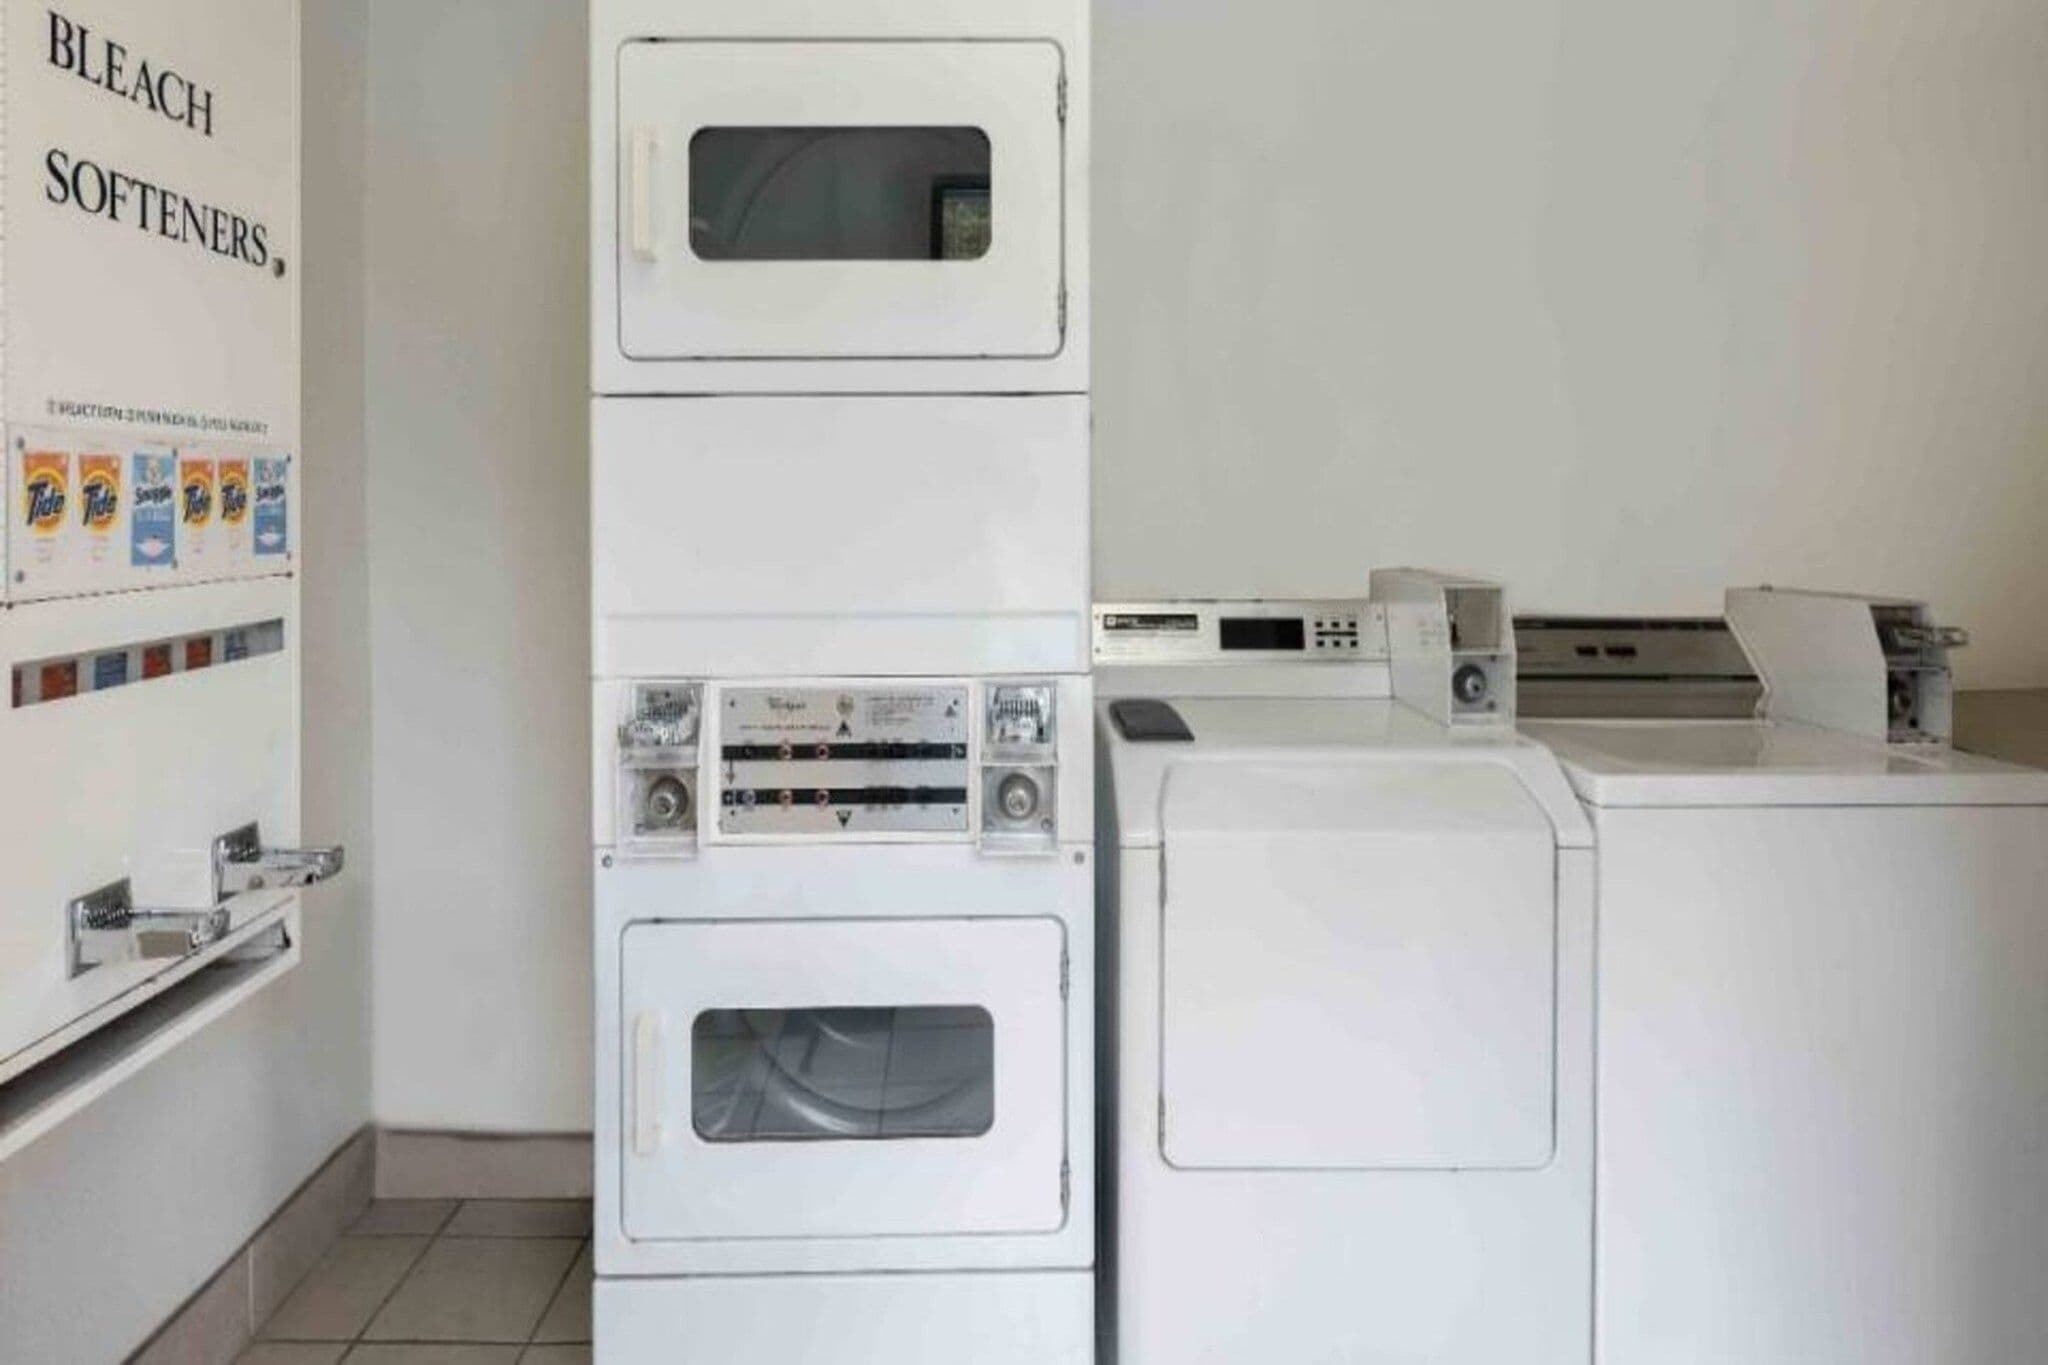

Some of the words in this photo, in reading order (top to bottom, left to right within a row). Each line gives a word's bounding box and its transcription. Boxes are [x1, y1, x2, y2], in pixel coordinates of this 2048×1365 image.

[48, 10, 212, 137] BLEACH
[45, 148, 268, 267] SOFTENERS
[27, 480, 65, 526] Tide
